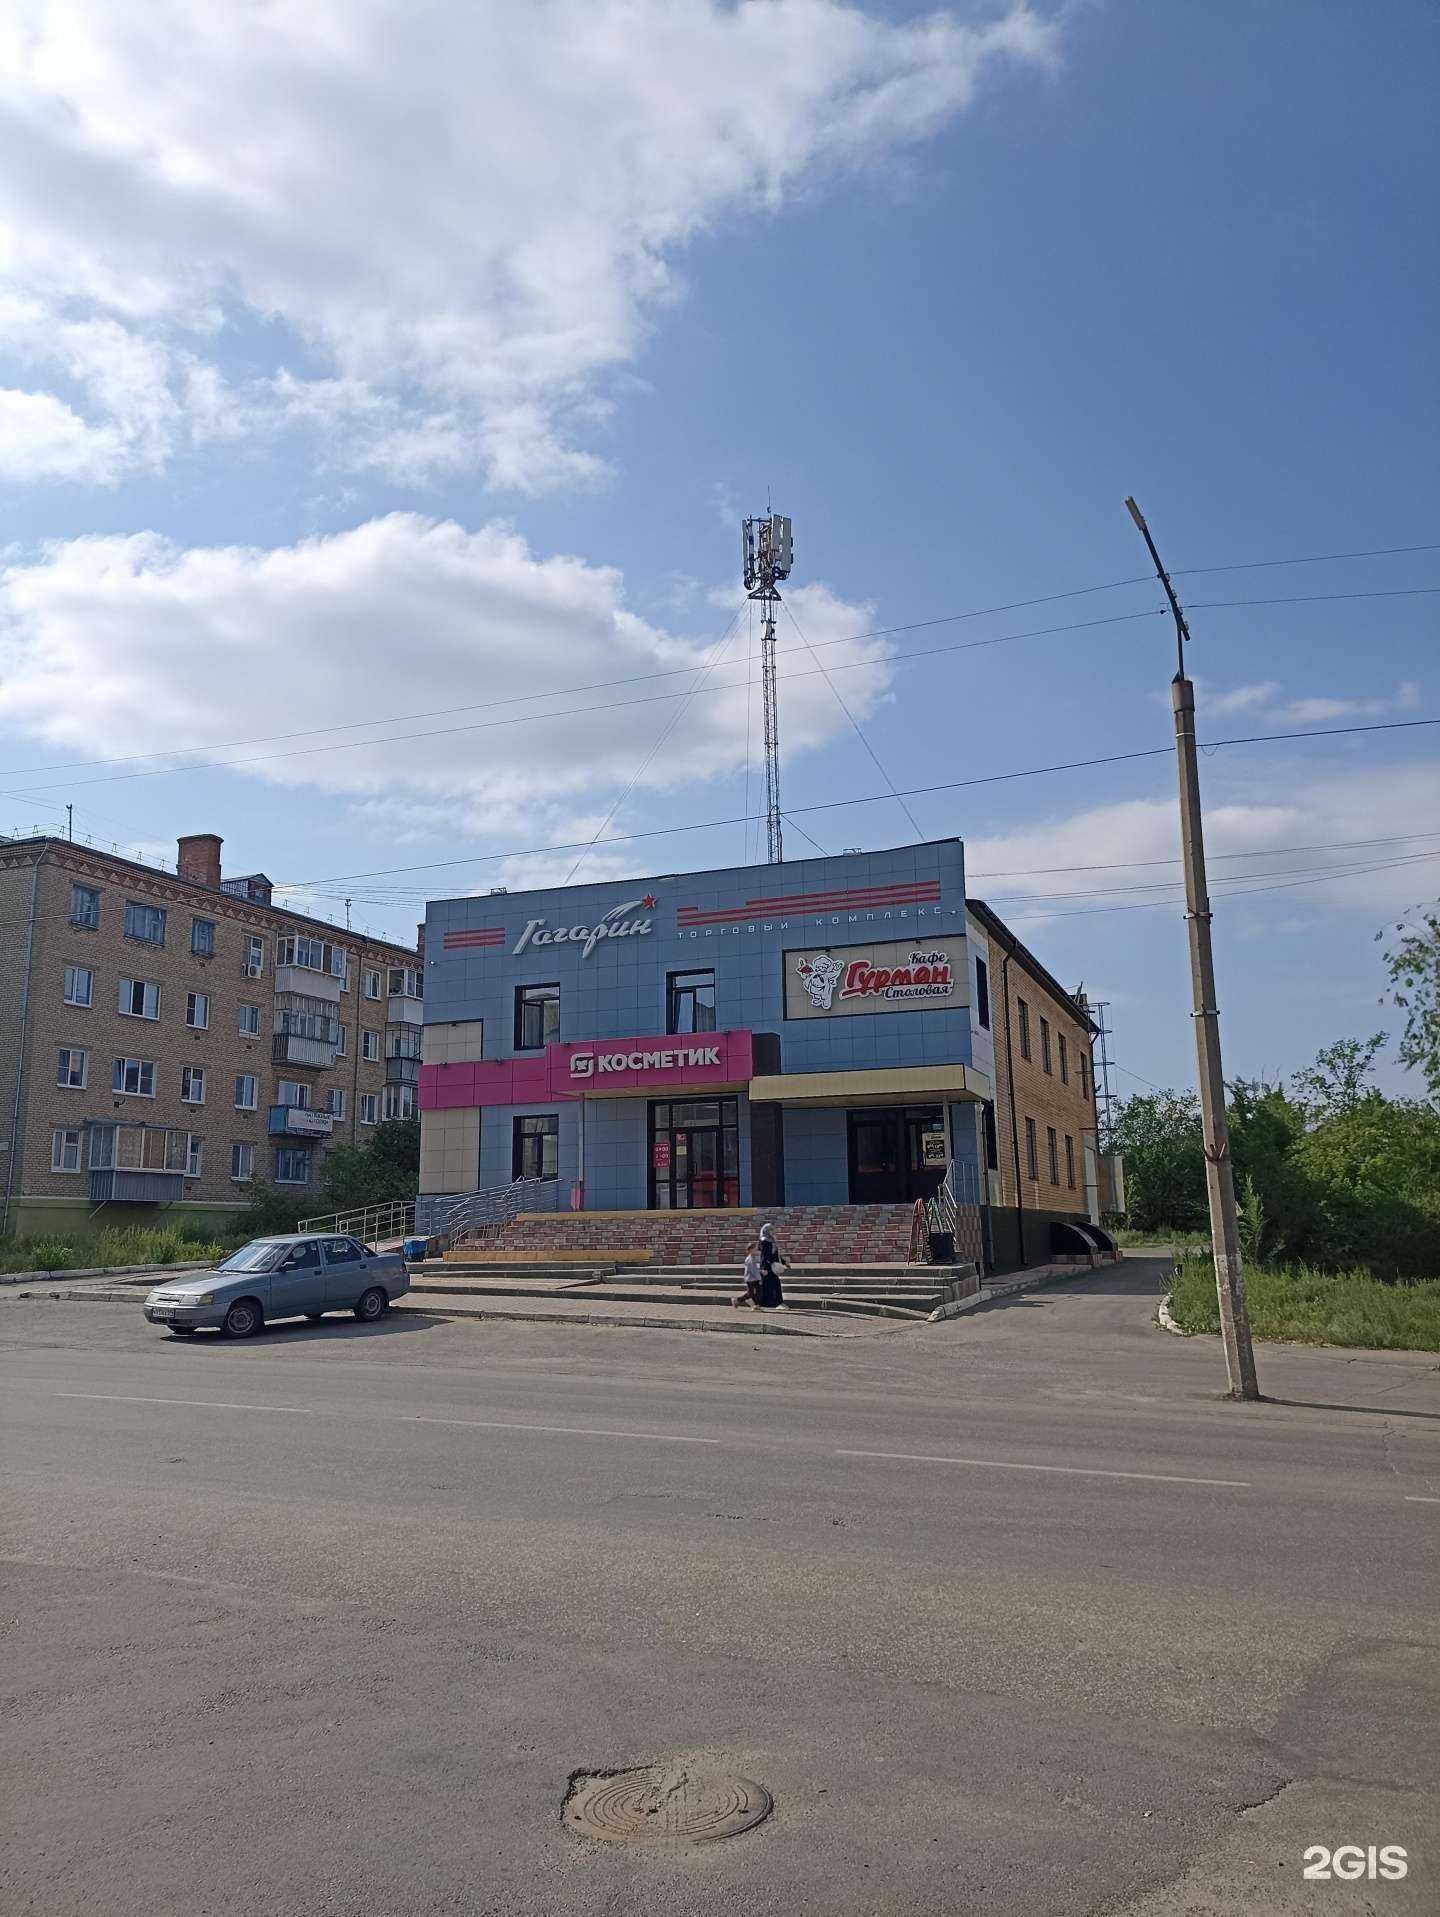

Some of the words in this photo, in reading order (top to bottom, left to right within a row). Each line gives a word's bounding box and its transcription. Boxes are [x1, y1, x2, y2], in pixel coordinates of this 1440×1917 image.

[816, 906, 941, 925] КОМПЛЕКС
[512, 903, 653, 958] Гагарин
[909, 951, 946, 966] Кафе
[842, 961, 950, 995] Гурман
[883, 985, 949, 999] Столовая
[598, 1046, 720, 1073] КОСМЕТИК
